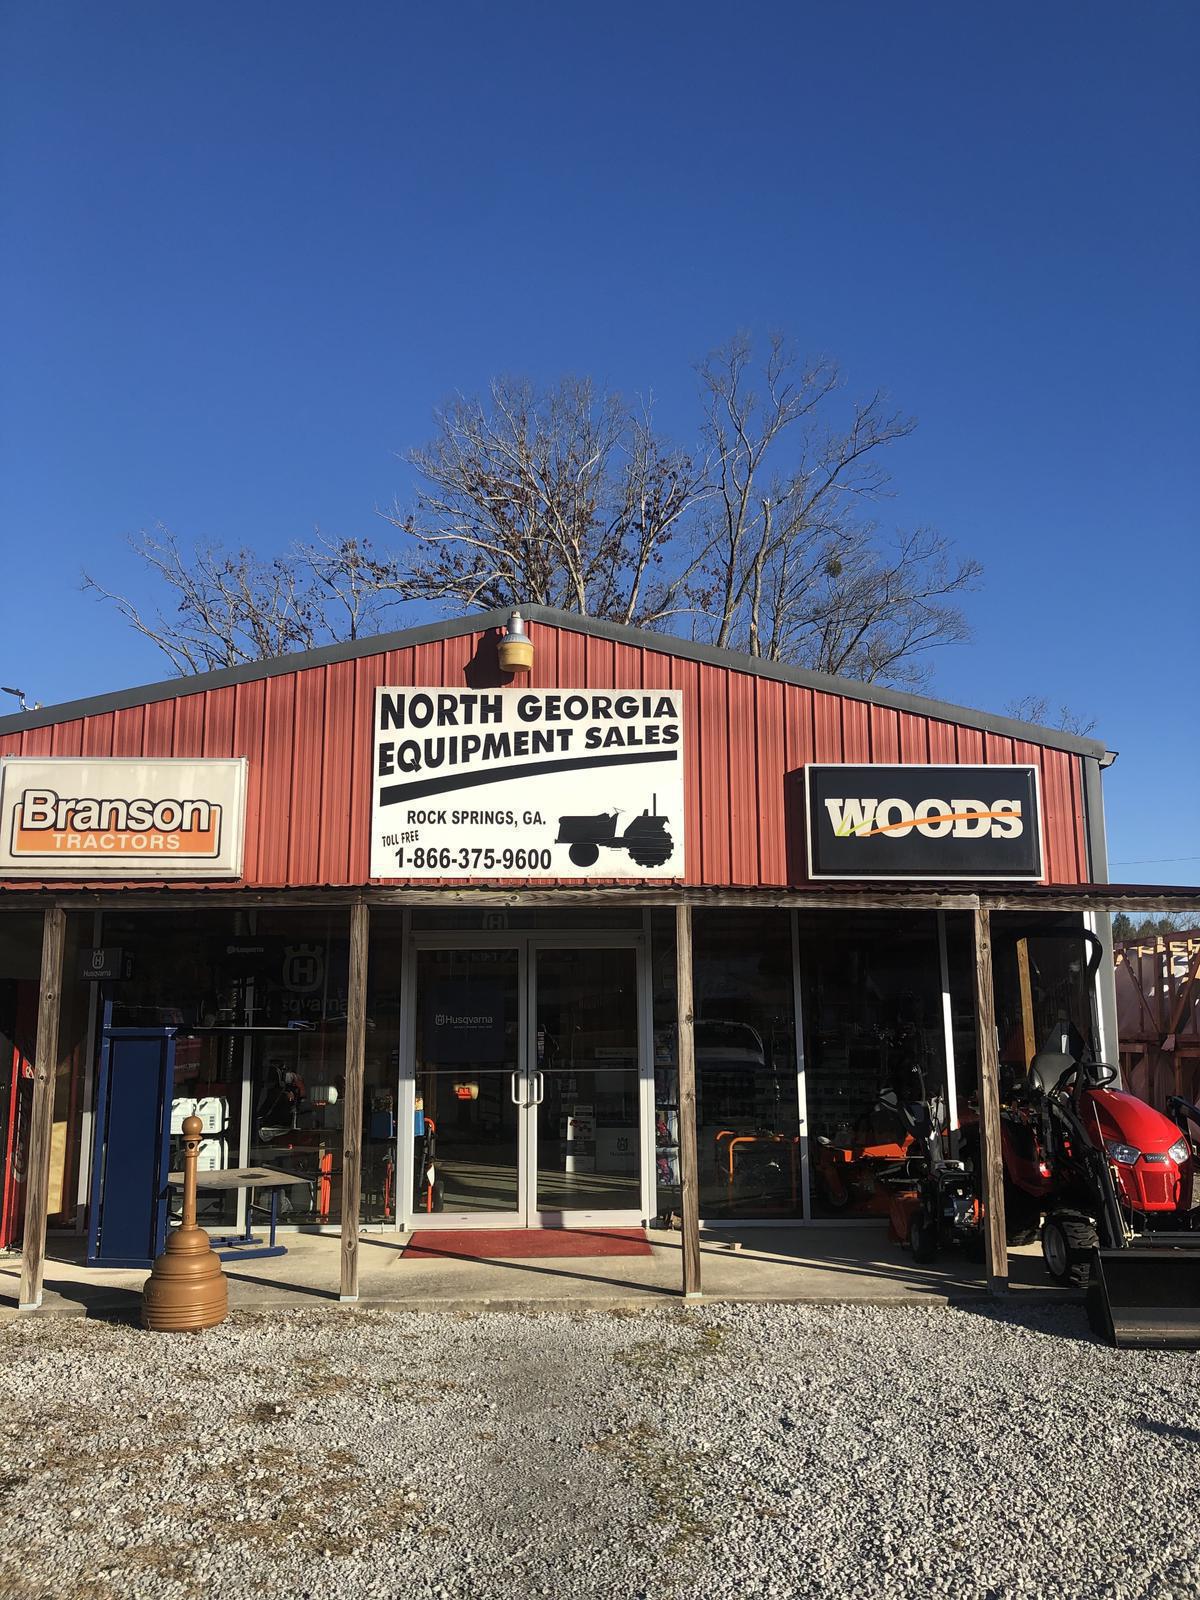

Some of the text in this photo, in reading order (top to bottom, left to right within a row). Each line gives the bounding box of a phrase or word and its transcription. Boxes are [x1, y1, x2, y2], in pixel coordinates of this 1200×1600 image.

[380, 693, 678, 730] NORTH GEORGIA
[378, 724, 680, 776] EQUIPMENT SALES
[20, 789, 211, 832] Branson
[407, 810, 546, 828] ROCK SPRINGS, GA.
[824, 798, 1024, 839] WOODS
[52, 833, 181, 850] TRACTORS
[381, 830, 420, 848] TOLL FREE
[394, 847, 552, 870] 1-866-375-9600
[445, 1015, 493, 1025] Husqvarna
